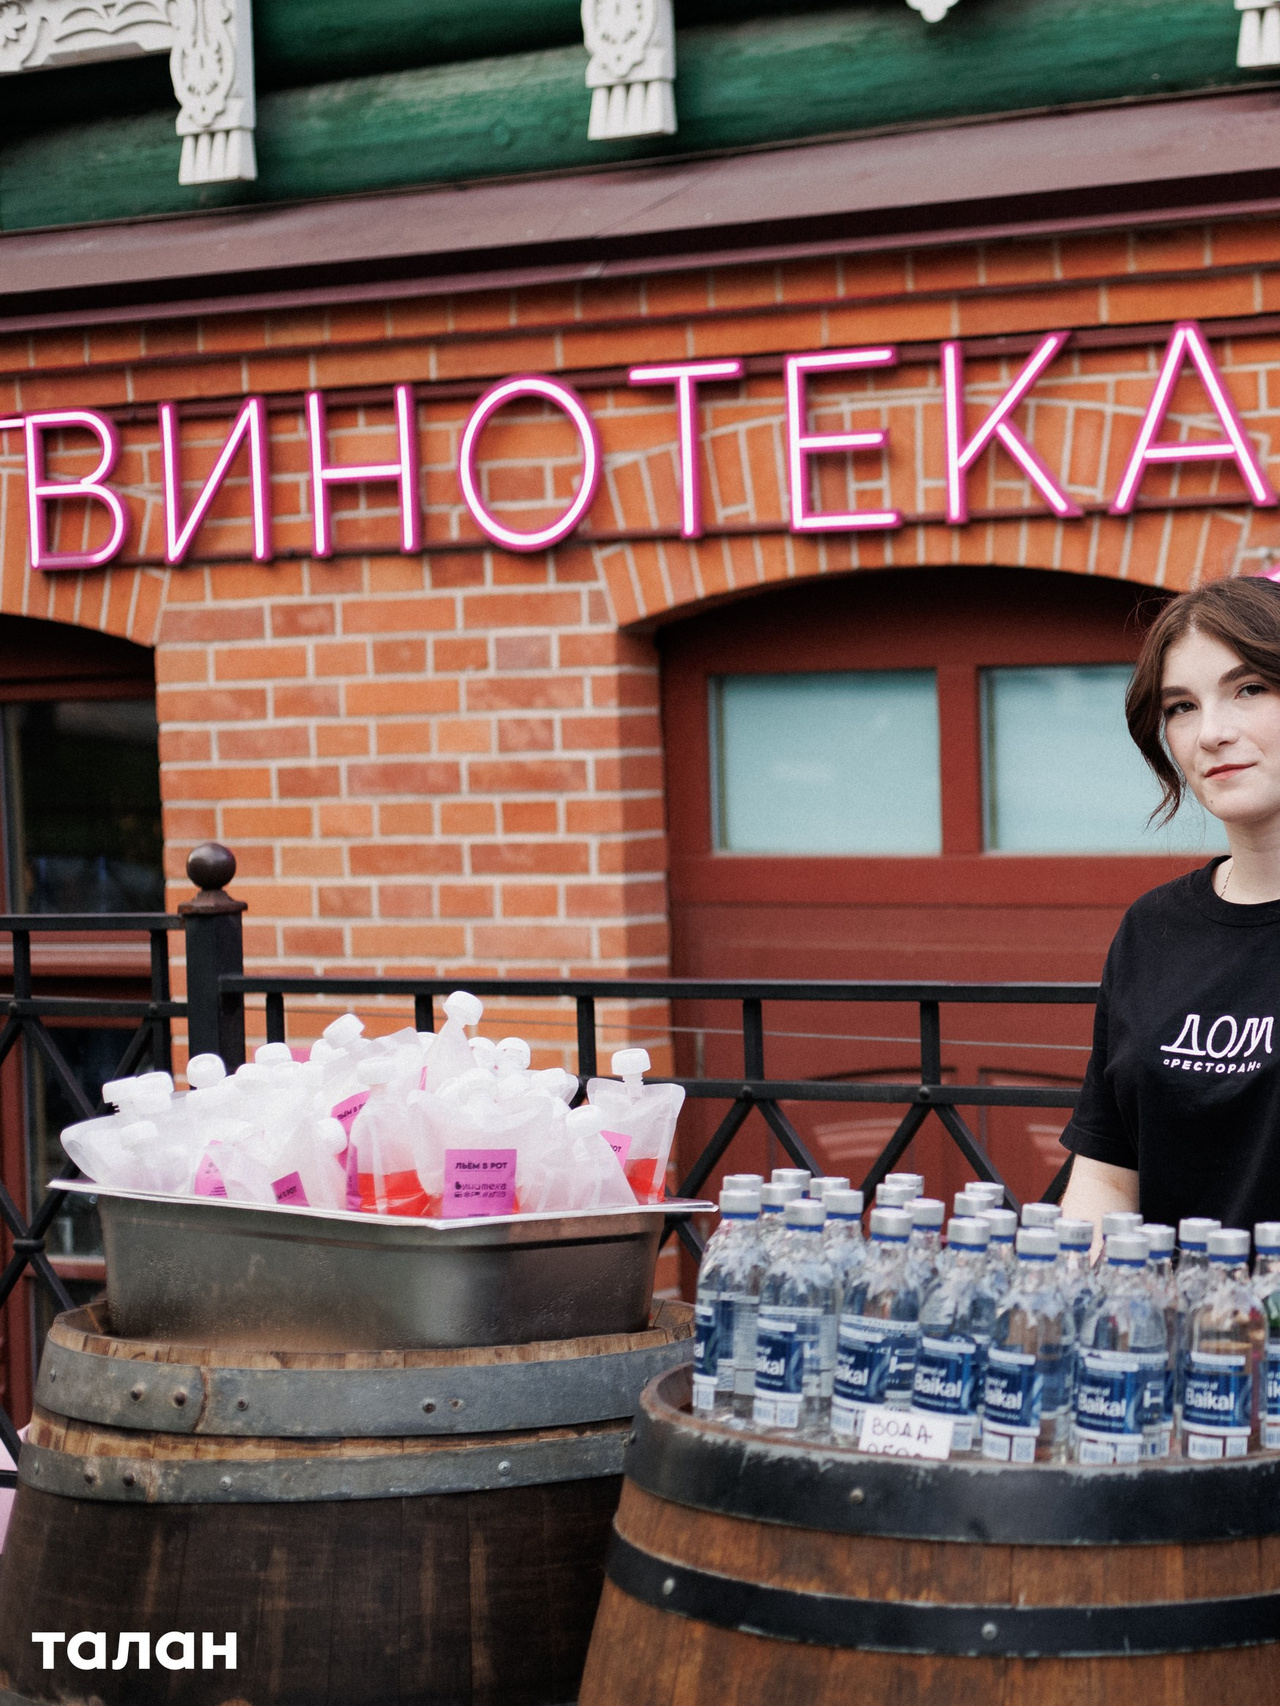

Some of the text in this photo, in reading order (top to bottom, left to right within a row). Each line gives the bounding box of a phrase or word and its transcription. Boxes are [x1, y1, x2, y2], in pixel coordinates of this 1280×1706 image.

[24, 322, 1278, 570] ВИНОТЕКА
[1160, 1014, 1274, 1059] ДОМ
[1169, 1058, 1257, 1074] РЕСТОРАН
[490, 1162, 508, 1170] РОТ
[914, 1371, 962, 1399] Baikal
[1185, 1386, 1235, 1412] Baikal
[872, 1417, 933, 1444] ВОДА
